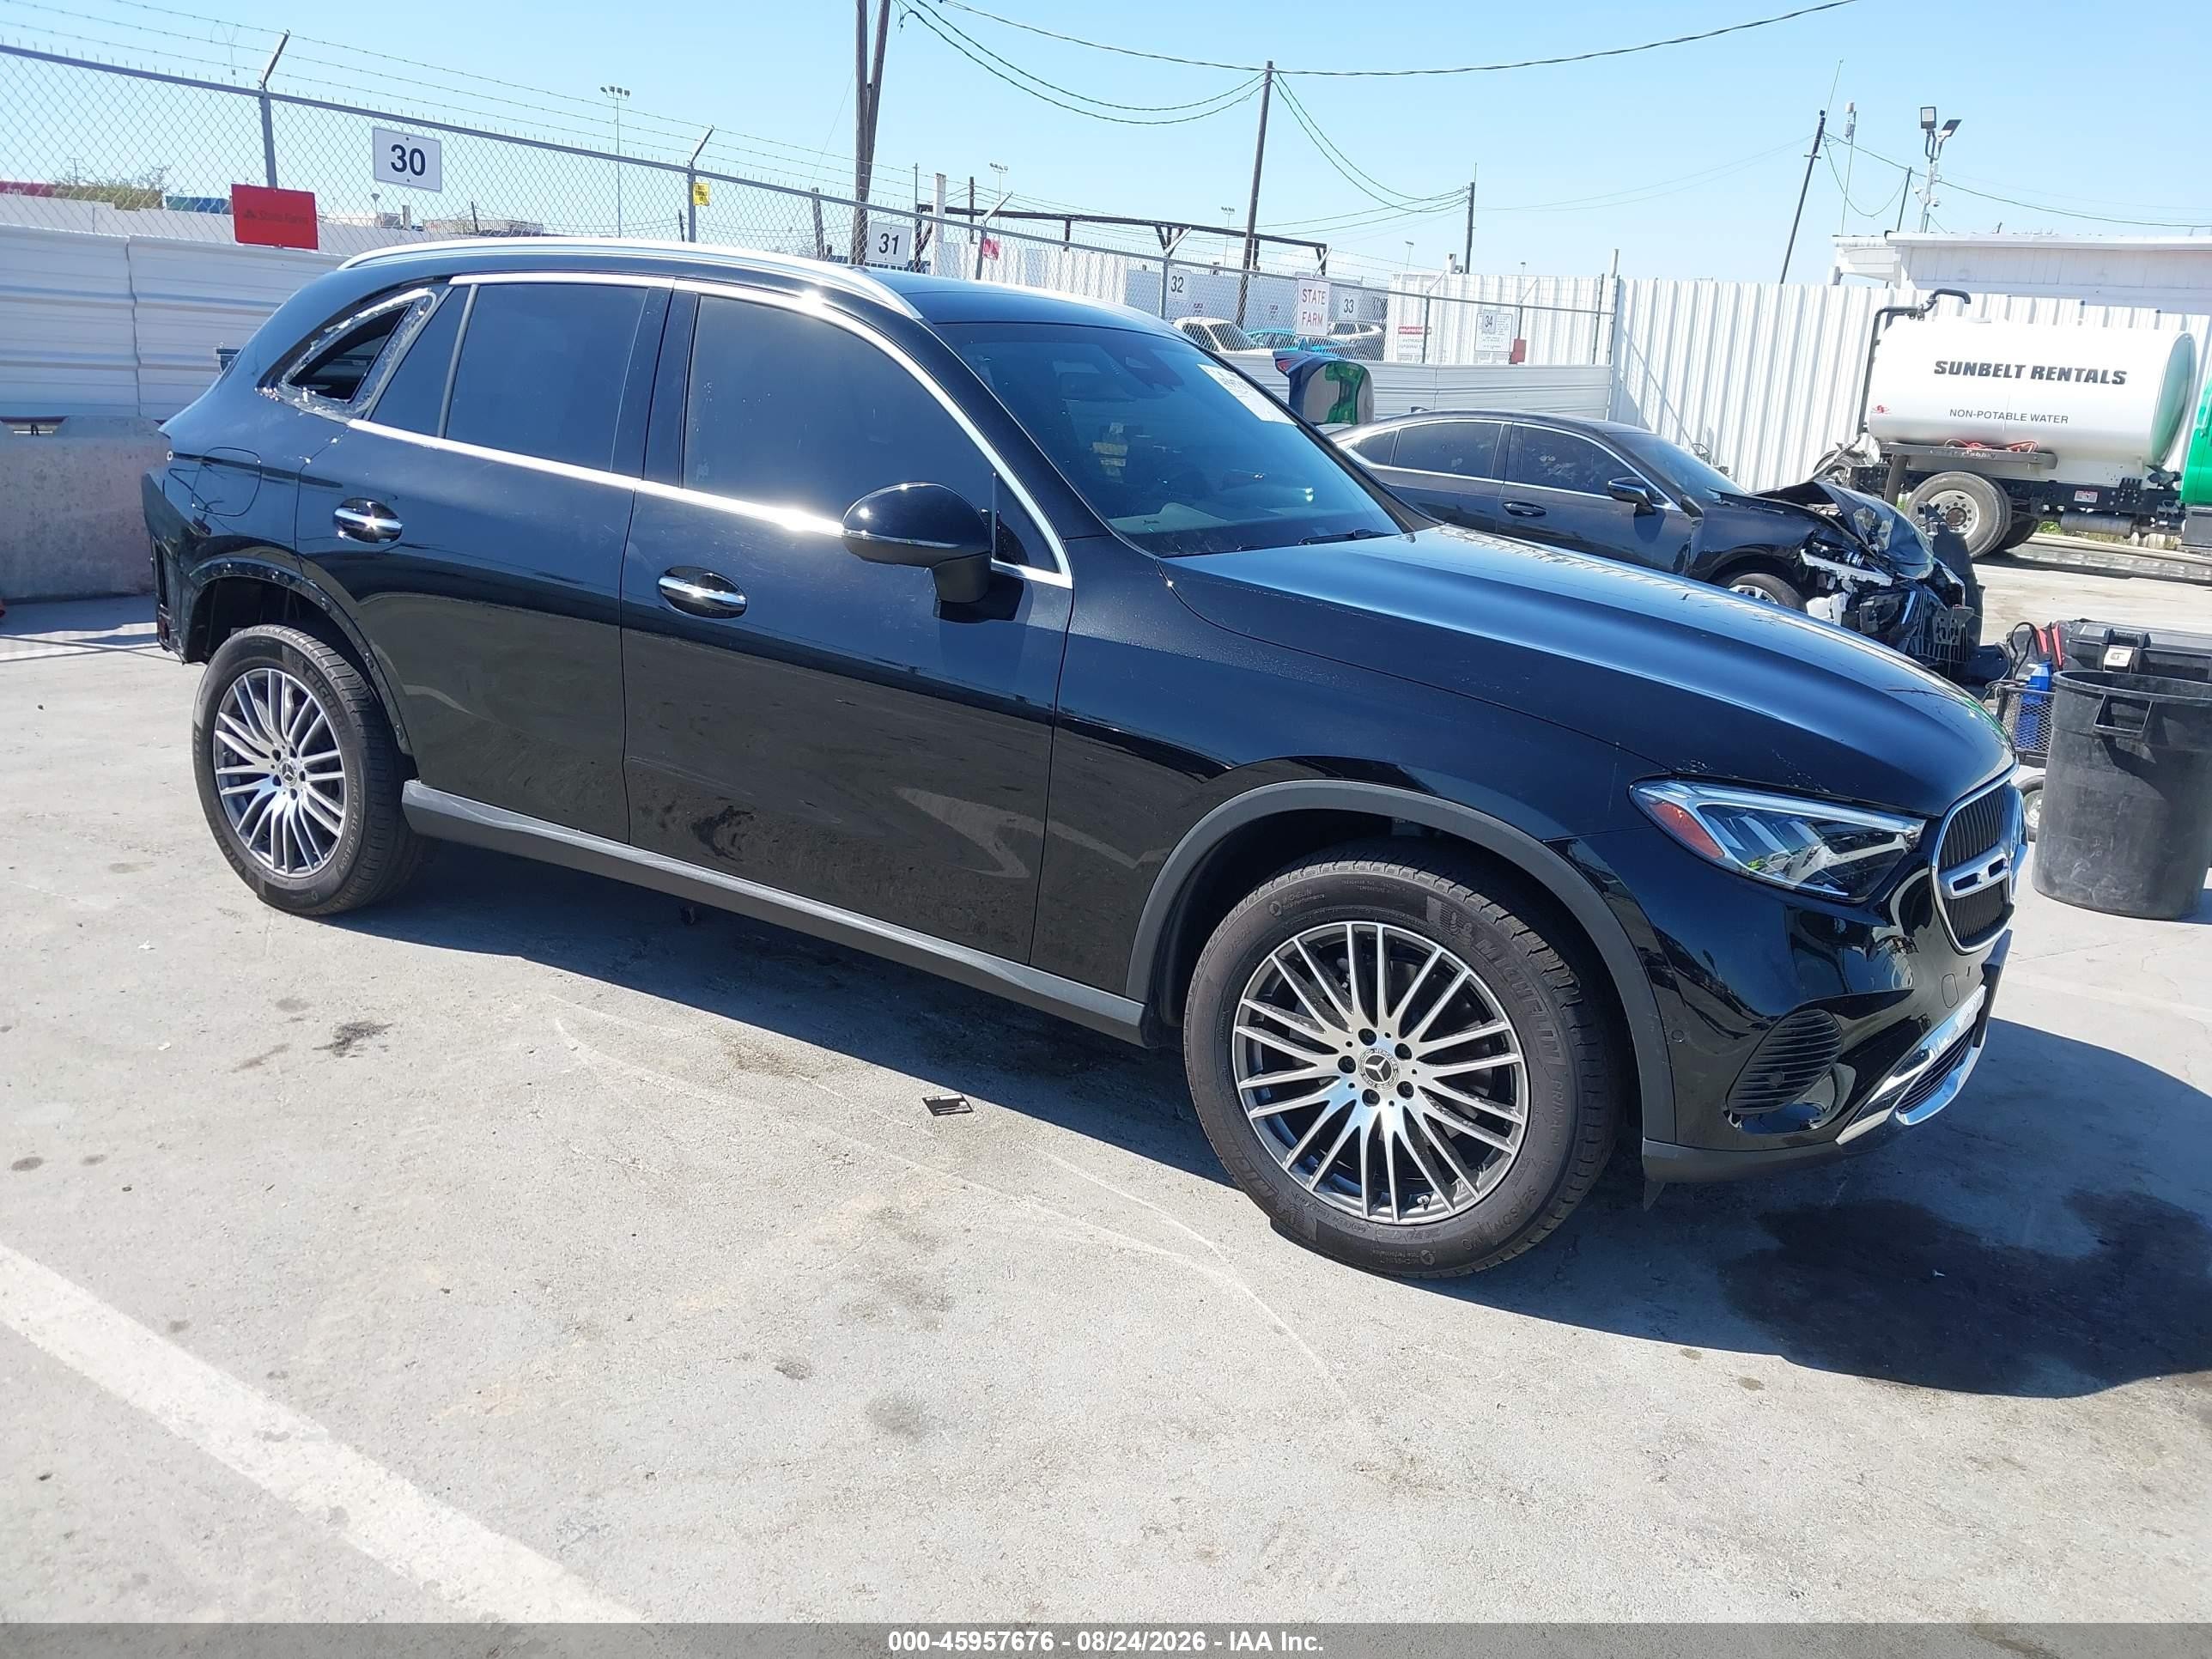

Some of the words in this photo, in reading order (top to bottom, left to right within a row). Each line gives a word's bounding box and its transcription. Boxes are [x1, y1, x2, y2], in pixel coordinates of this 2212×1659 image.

[391, 144, 426, 177] 30
[878, 233, 899, 255] 31
[1170, 276, 1184, 294] 32
[1302, 289, 1326, 305] STATE
[1343, 299, 1354, 313] 33
[1302, 312, 1324, 327] FARM
[1485, 315, 1493, 328] 34
[1934, 360, 2027, 380] SUNBELT
[2030, 365, 2128, 385] RENTALS
[1949, 409, 2027, 422] NON-POTABLE
[2030, 414, 2069, 424] WATER
